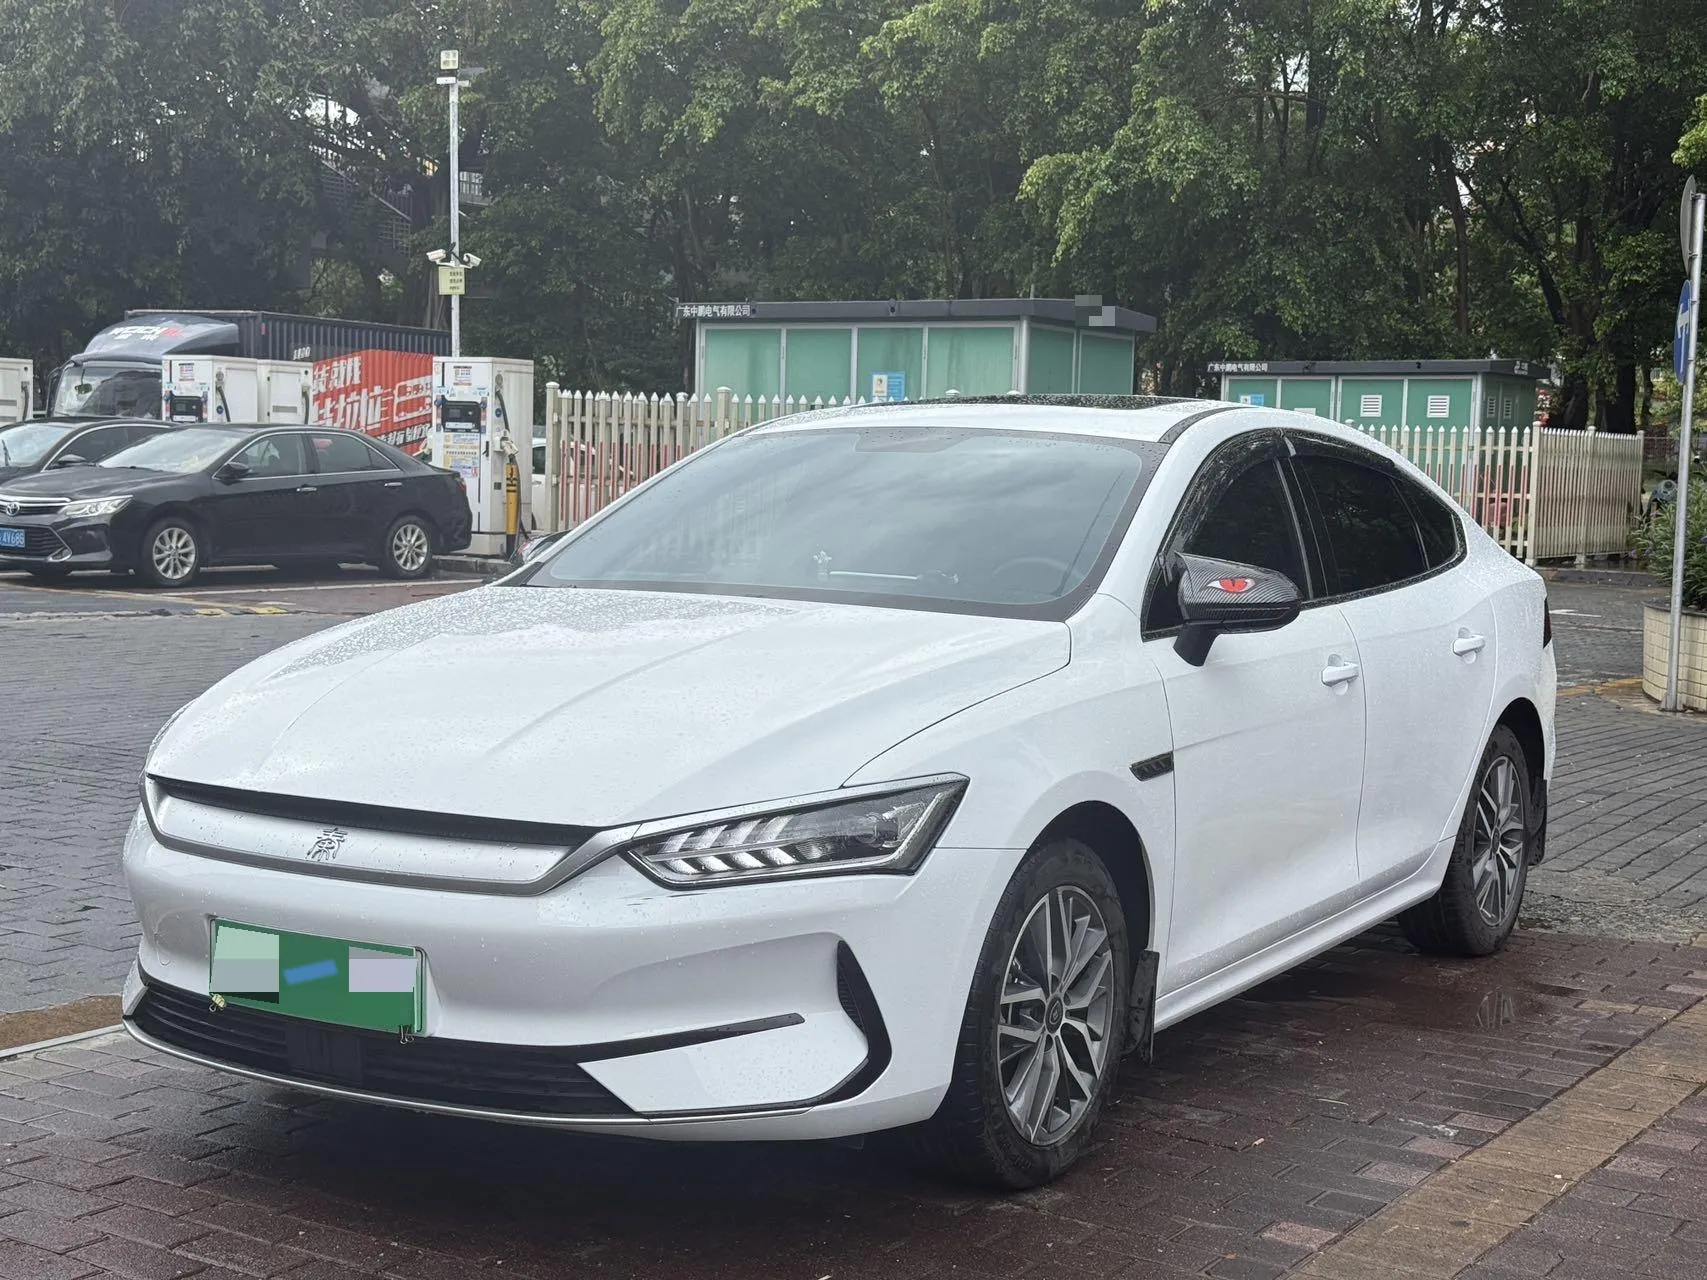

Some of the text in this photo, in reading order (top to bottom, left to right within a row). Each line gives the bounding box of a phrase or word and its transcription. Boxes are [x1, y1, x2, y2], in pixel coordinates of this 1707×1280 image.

[674, 304, 751, 317] 广东中鹏电气有限公司
